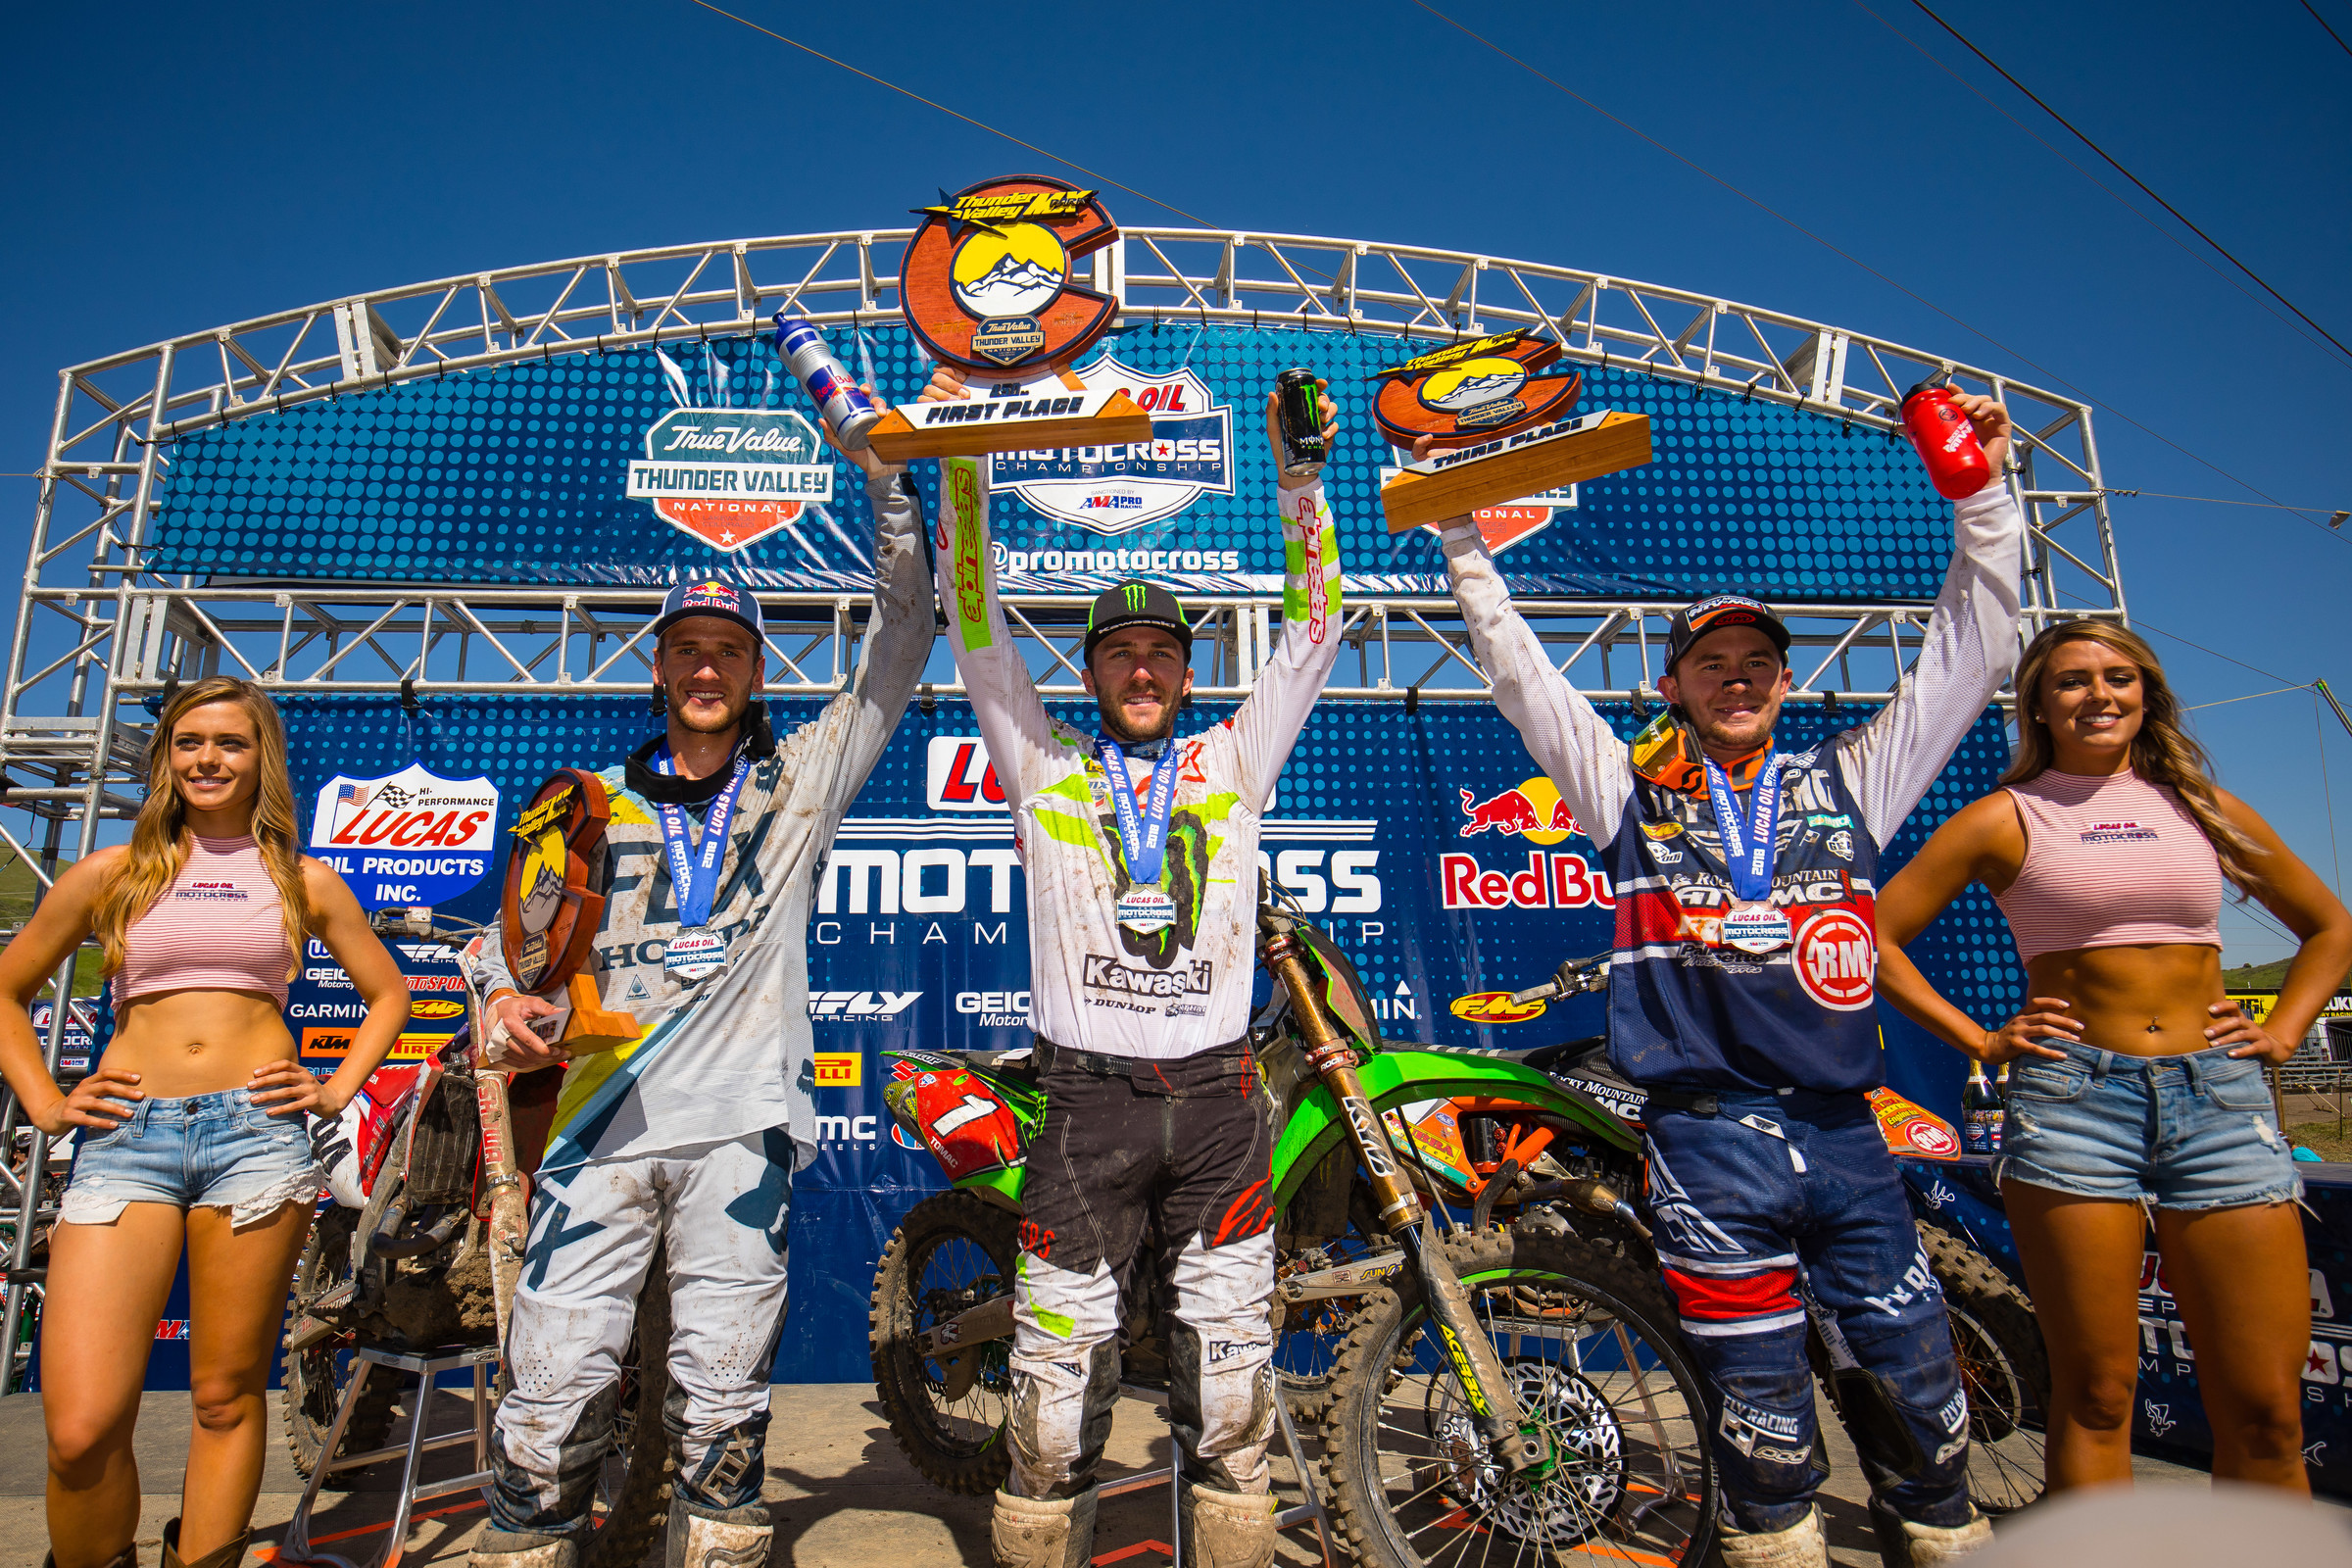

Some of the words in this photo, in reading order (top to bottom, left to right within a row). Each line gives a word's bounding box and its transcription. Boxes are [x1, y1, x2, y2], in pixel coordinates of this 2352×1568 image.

[955, 192, 1039, 209] Thunder
[961, 205, 1023, 220] Valley
[974, 337, 1008, 346] THUNDER
[1011, 334, 1041, 344] VALLEY
[1406, 341, 1477, 367] Thunder
[1415, 350, 1468, 369] Valley
[814, 377, 837, 401] Red
[1137, 384, 1190, 413] OIL
[925, 403, 1000, 424] FIRST
[1003, 396, 1085, 418] PLACE
[1299, 435, 1324, 445] MONS
[1434, 440, 1503, 468] THIRD
[1509, 417, 1584, 448] PLACE
[996, 461, 1222, 473] CHAMPIONSHIP
[634, 467, 737, 491] THUNDER
[744, 470, 828, 494] VALLEY
[673, 502, 786, 513] NATIONAL
[1079, 495, 1119, 509] AMA
[1472, 510, 1536, 519] IONAL
[991, 541, 1239, 576] @promotocross
[682, 597, 710, 609] Red
[711, 597, 740, 613] Bull
[1098, 619, 1176, 635] Kawasaki
[1101, 745, 1122, 772] LUCAS
[1157, 767, 1172, 785] OIL
[417, 797, 496, 808] PERFORMANCE
[1151, 783, 1169, 821] LUCAS
[1758, 787, 1775, 806] OIL
[710, 793, 731, 836] LUCAS
[1718, 788, 1744, 858] MOTOCROSS
[1753, 805, 1773, 844] LUCAS
[330, 809, 490, 848] LUCAS
[666, 816, 684, 840] OIL
[1146, 823, 1160, 849] 2018
[2081, 831, 2158, 842] MOTOCROSS
[2093, 822, 2122, 831] LUCAS
[318, 856, 355, 874] OIL
[362, 857, 485, 876] PRODUCTS
[702, 841, 717, 869] 2018
[1751, 848, 1766, 876] 2018
[669, 842, 686, 910] CHAMPIONSHI
[1440, 851, 1550, 909] Red
[1550, 854, 1617, 909] Bu
[1771, 868, 1839, 889] OUNTAIN
[374, 884, 422, 902] INC.
[1118, 907, 1173, 916] MOTOCROSS
[599, 905, 772, 971] HODA
[1725, 927, 1788, 936] MOTOCROSS
[673, 940, 701, 950] LUCAS
[702, 938, 715, 947] OIL
[666, 951, 724, 963] MOTOCROSS
[1815, 941, 1871, 980] RM
[306, 967, 351, 981] GEIC
[1083, 954, 1212, 998] Kawaski
[318, 980, 355, 991] Motorcy
[809, 992, 924, 1014] FLY
[956, 991, 1030, 1013] GEIC
[1093, 998, 1156, 1014] DUNLOP
[1451, 996, 1545, 1015] FMF
[309, 1035, 352, 1051] KTM
[393, 1038, 441, 1055] PIRE
[1584, 1080, 1648, 1105] MOUNTAIN
[932, 1093, 1002, 1141] 1
[930, 1135, 959, 1168] TOMAC
[1723, 1395, 1747, 1417] FLY
[1746, 1407, 1799, 1436] RACING
[1938, 1401, 1959, 1429] FLY
[702, 1426, 757, 1508] FOX
